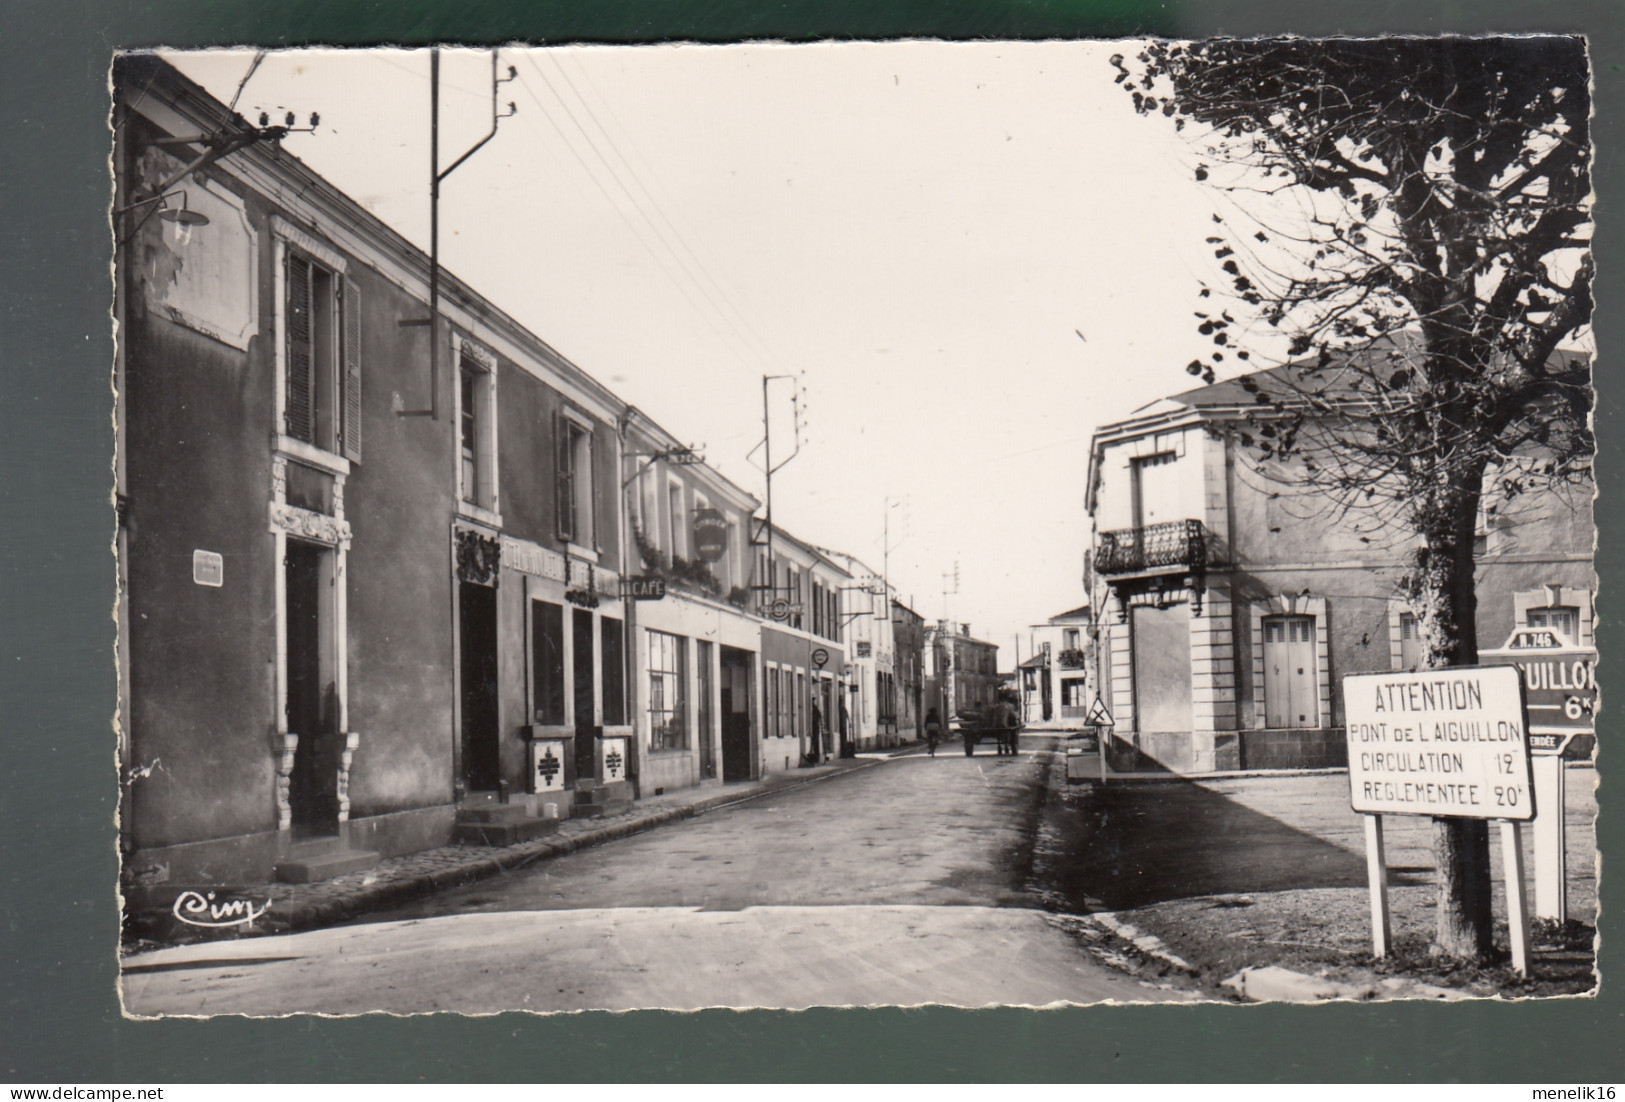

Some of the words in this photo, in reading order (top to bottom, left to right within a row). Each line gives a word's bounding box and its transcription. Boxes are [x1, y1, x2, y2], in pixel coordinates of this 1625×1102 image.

[1519, 633, 1552, 648] N.746
[1518, 661, 1596, 690] UILLO
[1375, 680, 1483, 713] ATTENTION
[1350, 722, 1388, 743] PONT
[1434, 721, 1522, 743] AIGUILLON
[1530, 735, 1556, 747] ENDÉE
[1361, 752, 1464, 773] CIRCULATION
[1364, 781, 1480, 806] REGLEMENTEE
